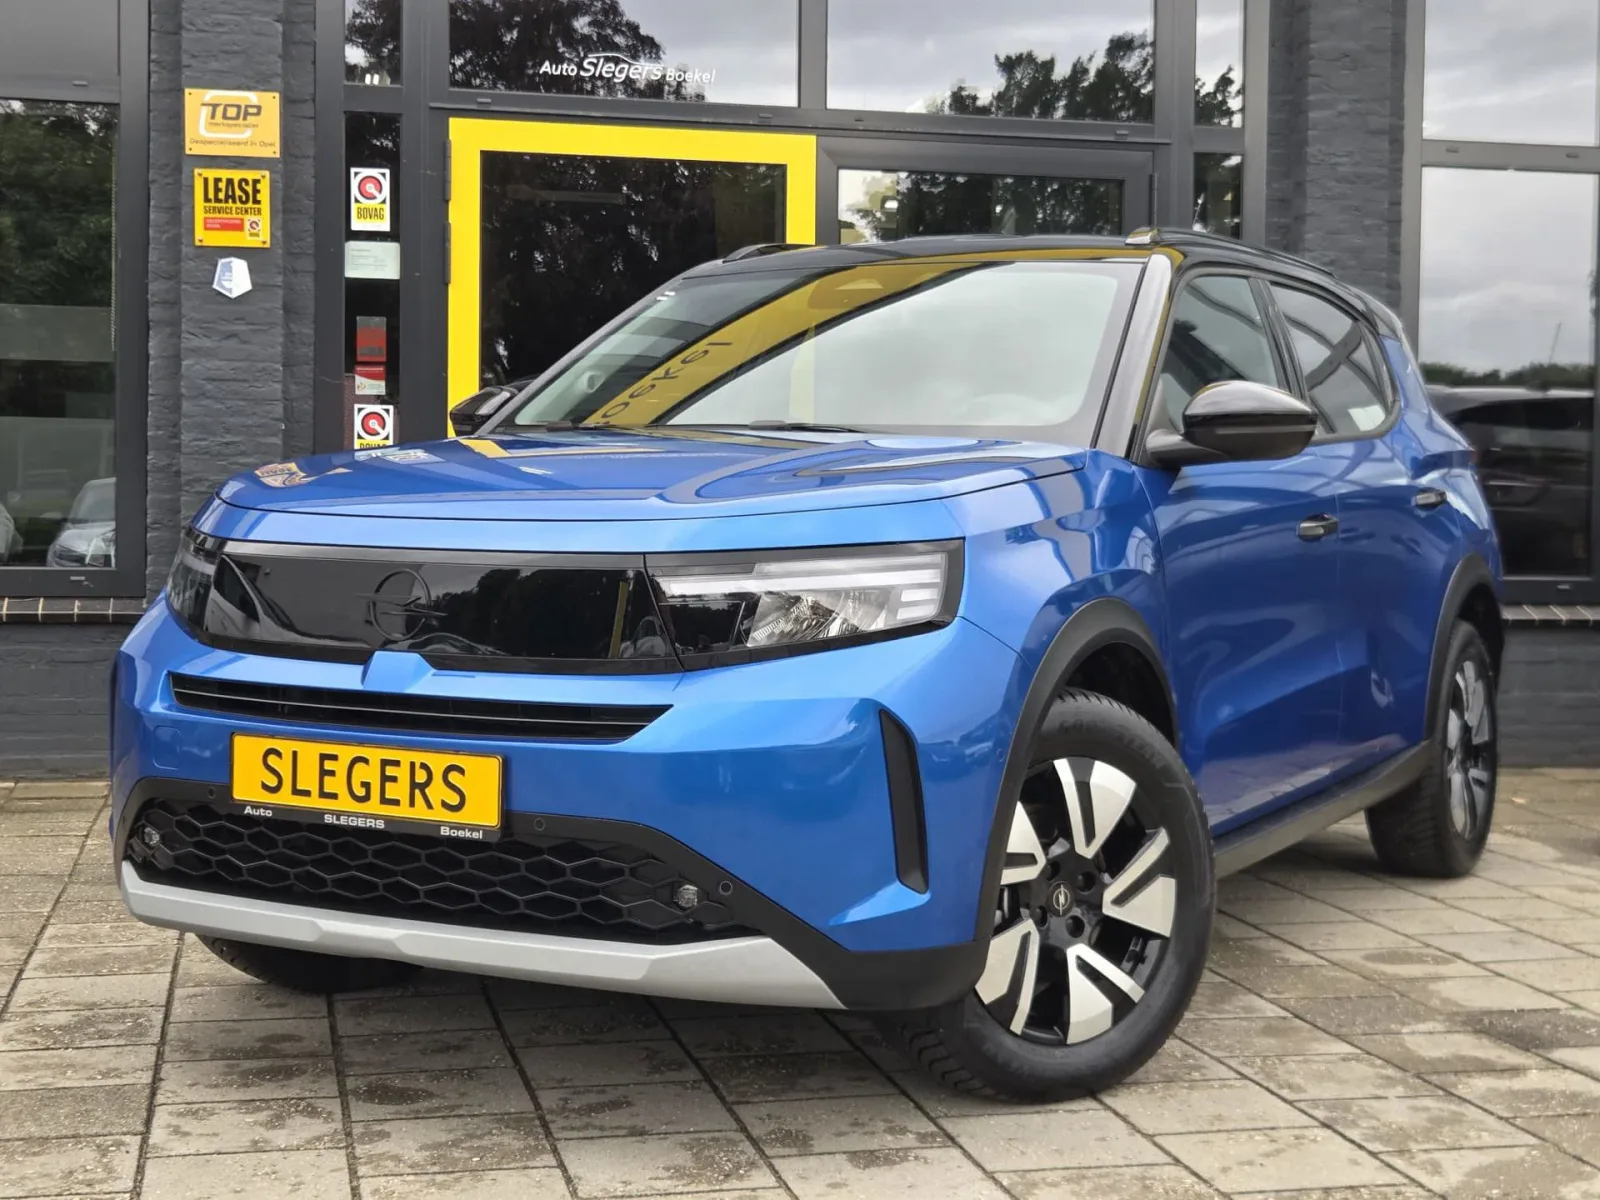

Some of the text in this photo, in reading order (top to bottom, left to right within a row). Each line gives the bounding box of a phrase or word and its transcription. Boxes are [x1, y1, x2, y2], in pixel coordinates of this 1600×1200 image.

[540, 57, 716, 84] Auto Slegers Boekel
[200, 102, 262, 121] TOP
[203, 177, 262, 205] LEASE
[203, 206, 262, 216] SERVICE CENTER
[356, 206, 385, 221] BOVAG
[260, 747, 467, 814] SLEGERS
[244, 805, 483, 840] Auto SLEGERS Boekel
